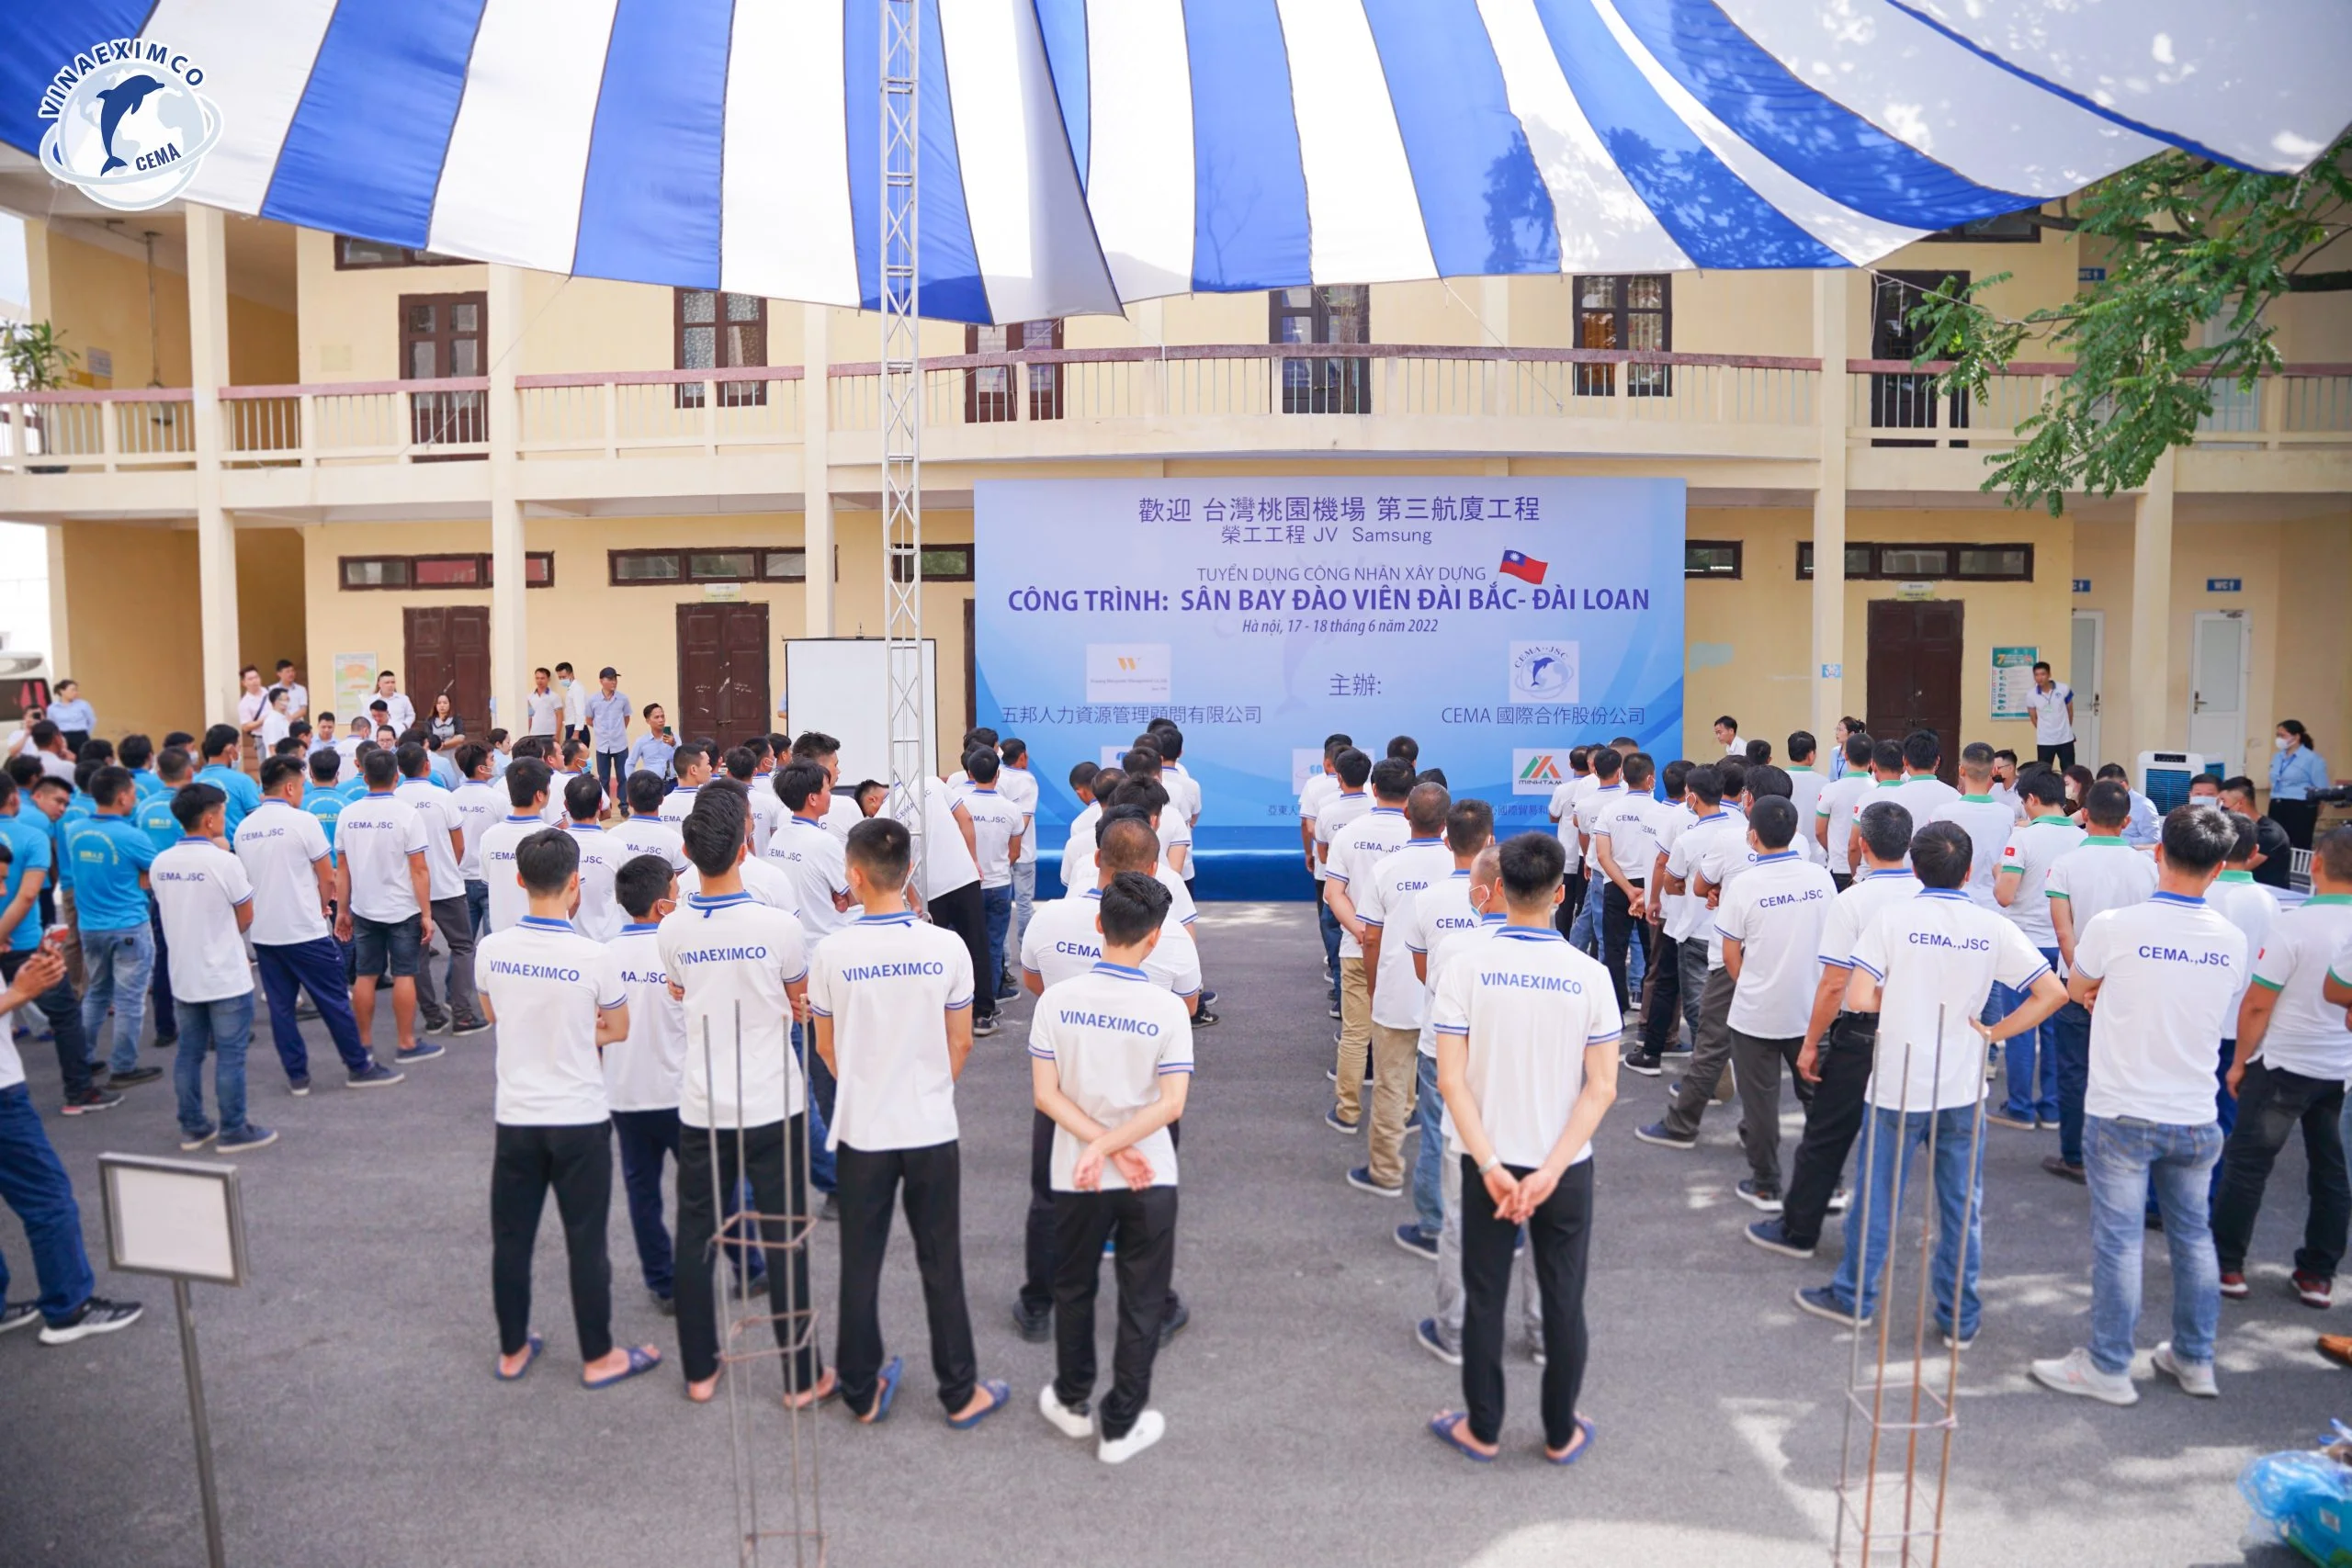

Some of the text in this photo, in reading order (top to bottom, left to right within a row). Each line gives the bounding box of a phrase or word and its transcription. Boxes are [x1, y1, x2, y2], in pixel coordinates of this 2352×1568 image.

[1138, 497, 1540, 523] 歡迎 台灣桃園機場 第三航廈工程
[1222, 525, 1432, 544] 榮工工程 JV Samsung
[1197, 564, 1487, 585] TUYỂN DỤNG CÔNG NHÂN XÂY DỰNG
[1009, 586, 1078, 612] CÔNG
[1085, 586, 1168, 611] TRÌNH:
[1182, 585, 1230, 611] SÂN
[1239, 589, 1286, 610] BAY
[1293, 585, 1346, 610] ĐÀO
[1352, 584, 1410, 610] VIÊN
[1418, 585, 1461, 610] ĐÀI
[1532, 585, 1576, 610] ĐÀI
[1584, 589, 1649, 610] LOAN
[1243, 619, 1258, 633] Hà
[1261, 619, 1283, 635] nội,
[1288, 620, 1302, 632] 17
[1314, 620, 1327, 632] 18
[1330, 619, 1365, 636] tháng
[1368, 620, 1375, 632] 6
[1379, 619, 1405, 632] năm
[1408, 620, 1439, 632] 2022
[1329, 673, 1382, 696] 主辦:
[1002, 705, 1261, 726] 五邦人力資源管理顧問有限公司
[1442, 706, 1645, 725] CEMA 國際合作股份公司
[1759, 889, 1824, 908] CEMA.,JSC
[1056, 942, 1102, 959] CEMA
[1909, 932, 1990, 952] CEMA.,JSC
[677, 946, 767, 965] VINAEXIMCO
[2139, 945, 2230, 967] CEMA.,JSC
[490, 960, 580, 982] VINAEXIMCO
[842, 961, 944, 983] VINAEXIMCO
[1481, 972, 1582, 995] VINAEXIMCO
[1060, 1010, 1159, 1037] VINAEXIMCO
